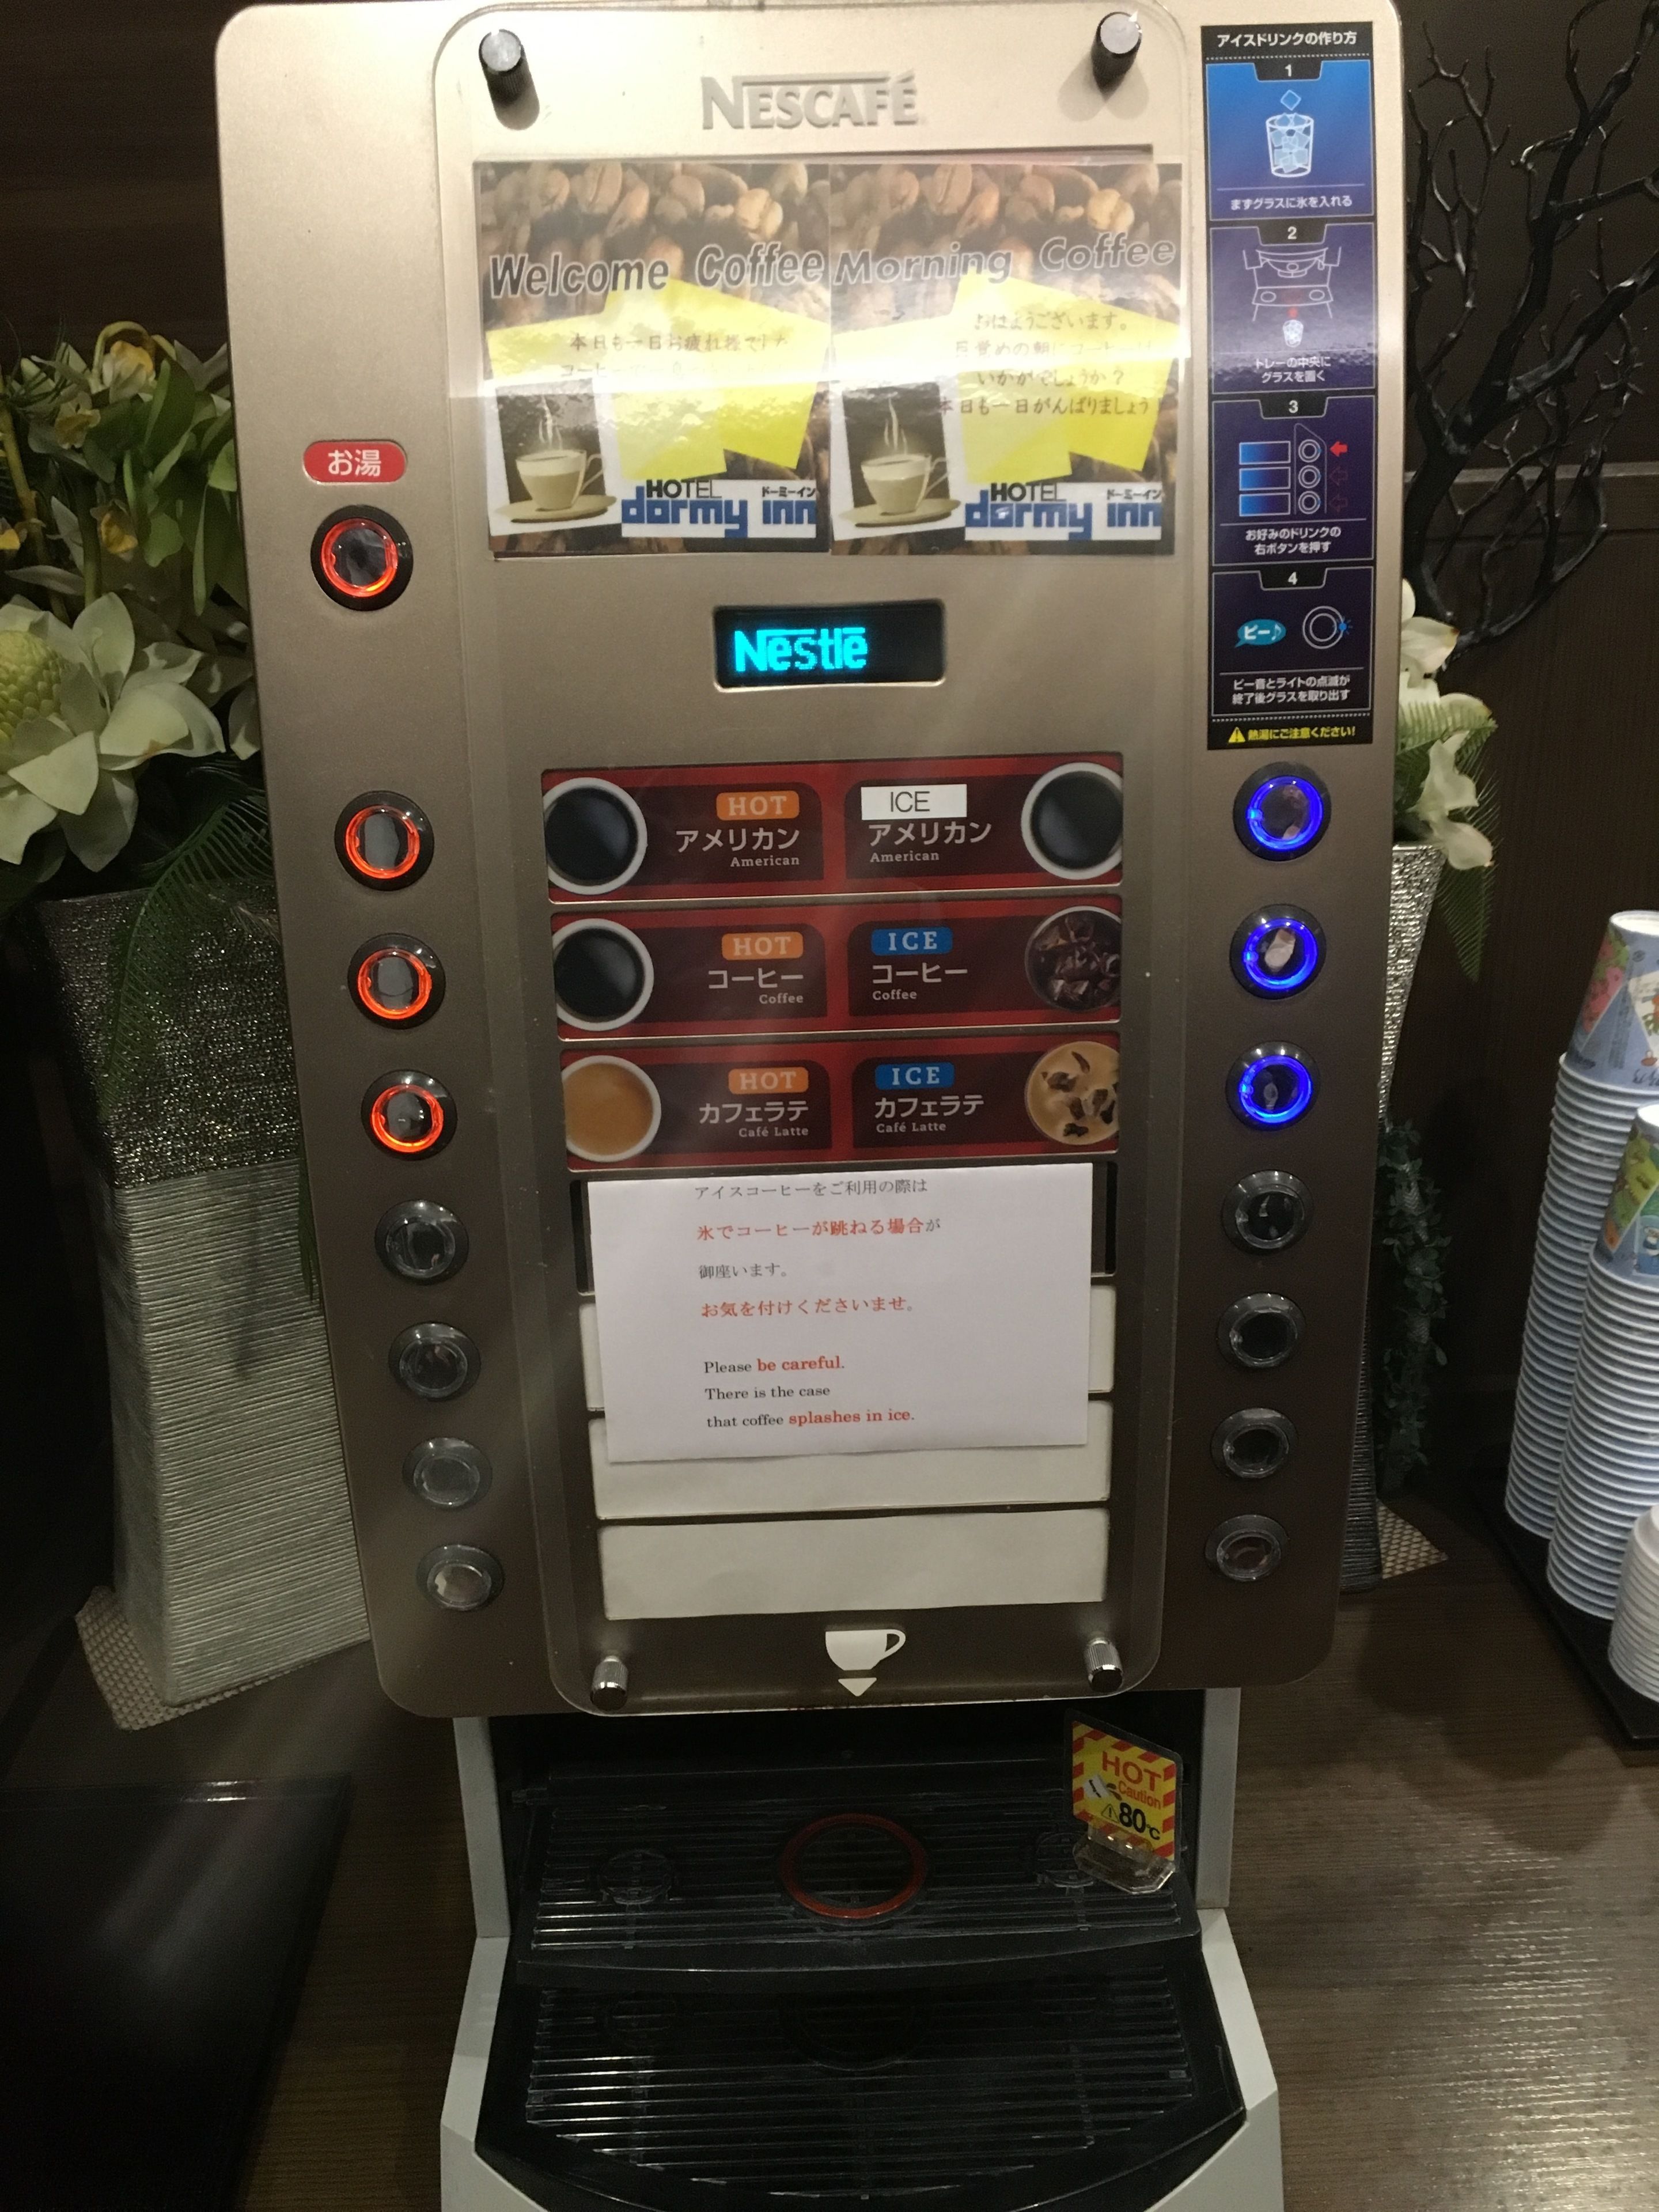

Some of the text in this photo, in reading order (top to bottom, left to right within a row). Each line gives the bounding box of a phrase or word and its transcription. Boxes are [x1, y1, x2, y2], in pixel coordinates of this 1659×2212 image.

[1217, 31, 1357, 48] アイスドリンクの作り方
[1285, 65, 1293, 77] 1
[700, 67, 918, 130] NESCAFÉ
[1230, 195, 1353, 211] まずグラスに氷を入れる
[1287, 226, 1297, 240] 2
[833, 232, 1176, 285] Morning Coffee
[490, 241, 825, 299] Welcome Coffee
[1288, 400, 1298, 414] 3
[328, 449, 381, 477] お湯
[645, 479, 722, 499] HOTEL
[762, 486, 816, 498] ドーミーイン
[990, 483, 1067, 502] HOTEL
[1106, 488, 1162, 501] ドーミーイン
[622, 486, 816, 539] dormy inn
[965, 489, 1162, 540] dormy inn
[1245, 526, 1342, 541] お好みのドリンクの
[1254, 541, 1332, 556] 右ボタンを押す
[1287, 571, 1298, 585] 4
[728, 795, 787, 816] HOT
[890, 790, 930, 813] ICE
[675, 827, 800, 854] アメリカン
[868, 820, 993, 847] アメリカン
[730, 855, 800, 868] American
[869, 850, 940, 863] American
[733, 936, 791, 956] HOT
[888, 931, 938, 952] ICE
[708, 968, 804, 989] コーヒー
[872, 962, 968, 984] コーヒー
[759, 993, 804, 1005] Coffee
[872, 989, 918, 1001] Coffee
[740, 1071, 796, 1090] HOT
[891, 1066, 941, 1086] ICE
[699, 1100, 809, 1125] カフェラテ
[874, 1094, 984, 1119] カフェラテ
[738, 1126, 809, 1138] Café Latte
[876, 1121, 947, 1134] Café Latte
[695, 1177, 929, 1200] アイスコーヒーをご利用の際は
[697, 1217, 941, 1241] 氷でコーヒーが跳ねる場合が
[699, 1262, 789, 1280] 御座います。
[700, 1296, 914, 1318] お気を付けくださいませ。
[703, 1355, 845, 1374] Please be careful.
[704, 1386, 831, 1401] There is the case
[706, 1408, 915, 1428] that coffee splashes in ice.
[1102, 1751, 1162, 1792] HOT
[1118, 1779, 1162, 1810] Caution
